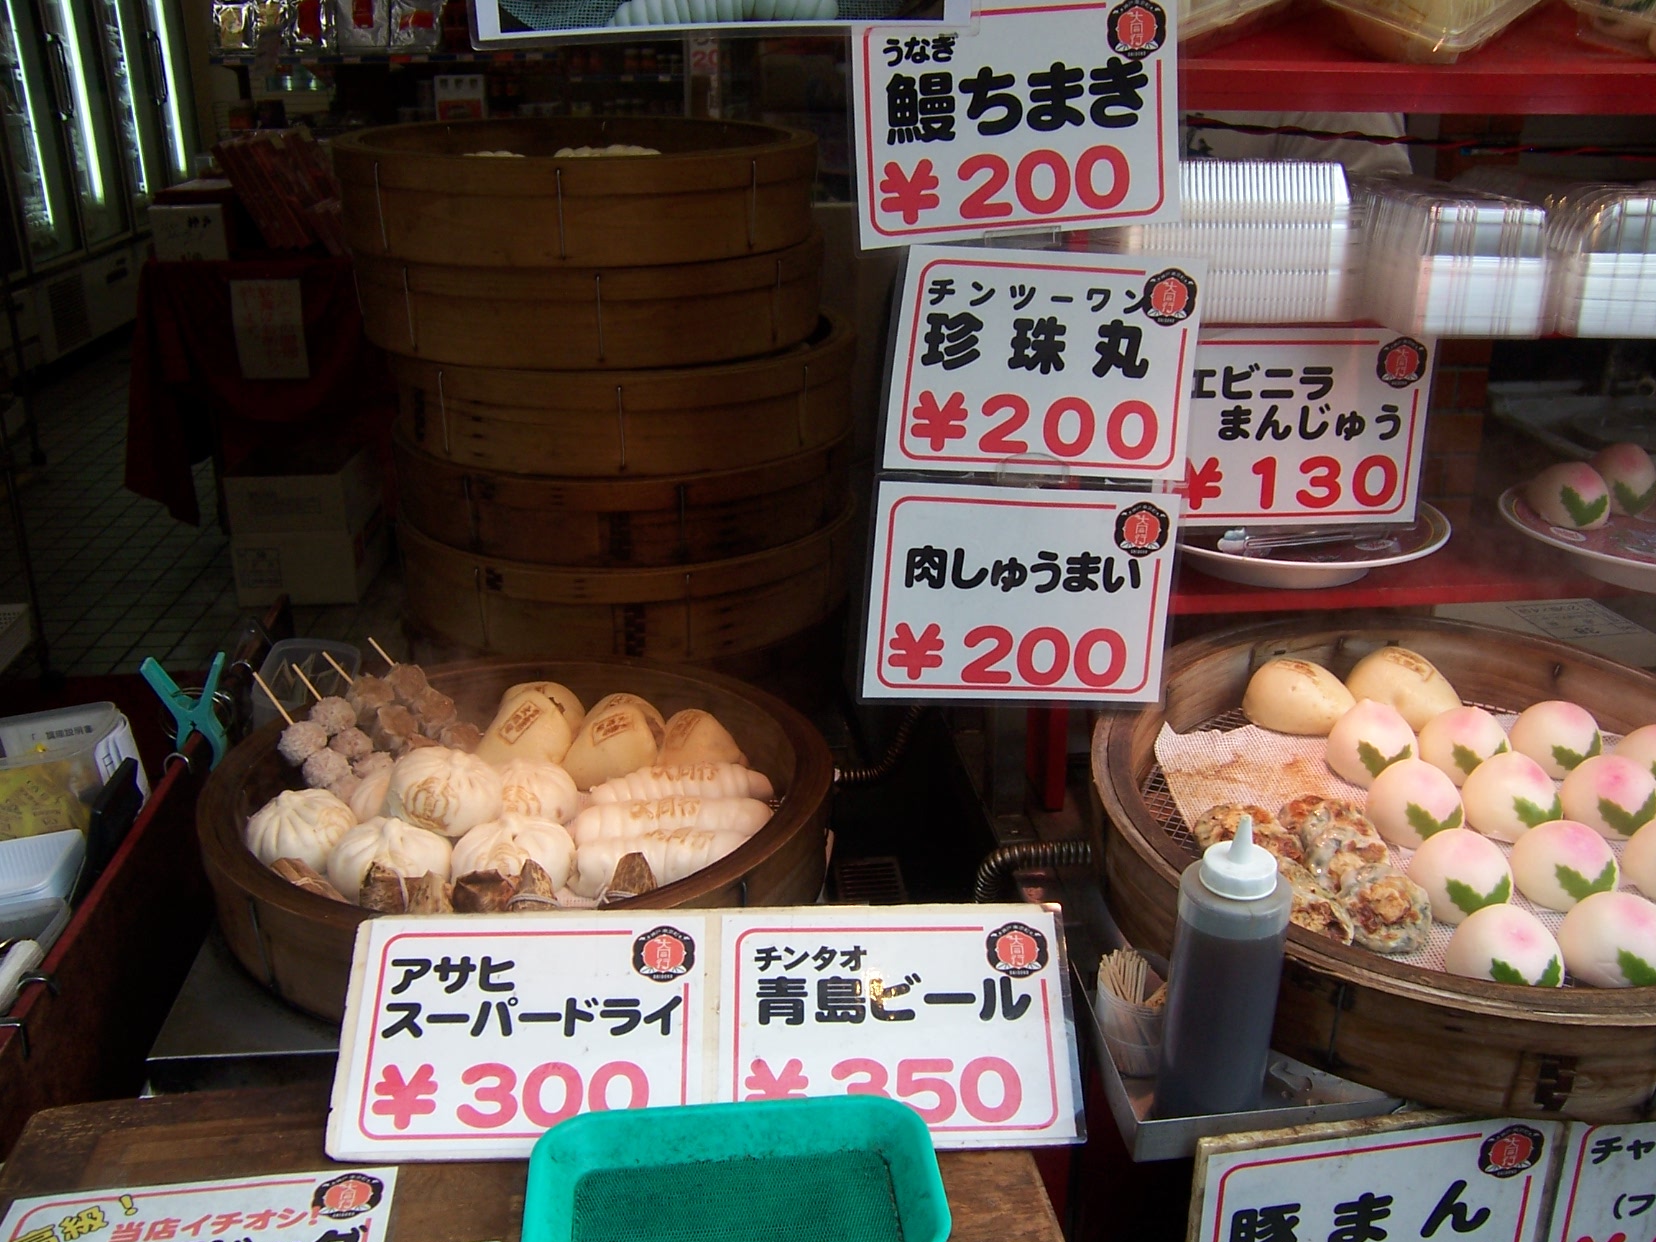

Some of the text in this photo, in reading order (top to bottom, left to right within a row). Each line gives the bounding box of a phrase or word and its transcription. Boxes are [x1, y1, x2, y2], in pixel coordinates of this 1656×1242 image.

[883, 36, 955, 67] うなぎ
[885, 57, 1149, 145] 鰻ちまき
[879, 145, 1131, 225] ¥200
[928, 279, 1144, 314] チンツーワン
[921, 312, 1149, 379] 珍珠丸
[1191, 362, 1334, 400] エビニラ
[911, 390, 1159, 461] ¥200
[1218, 403, 1402, 441] まんじゅう
[905, 545, 1141, 593] 肉しゅうまい
[888, 623, 1127, 687] ¥200
[391, 956, 515, 995] アサヒ
[754, 945, 867, 972] チンタオ
[381, 996, 683, 1038] スーパードライ
[755, 972, 1032, 1026] 青島ビール
[371, 1060, 650, 1130] ¥300
[1229, 1179, 1491, 1242] 豚まん
